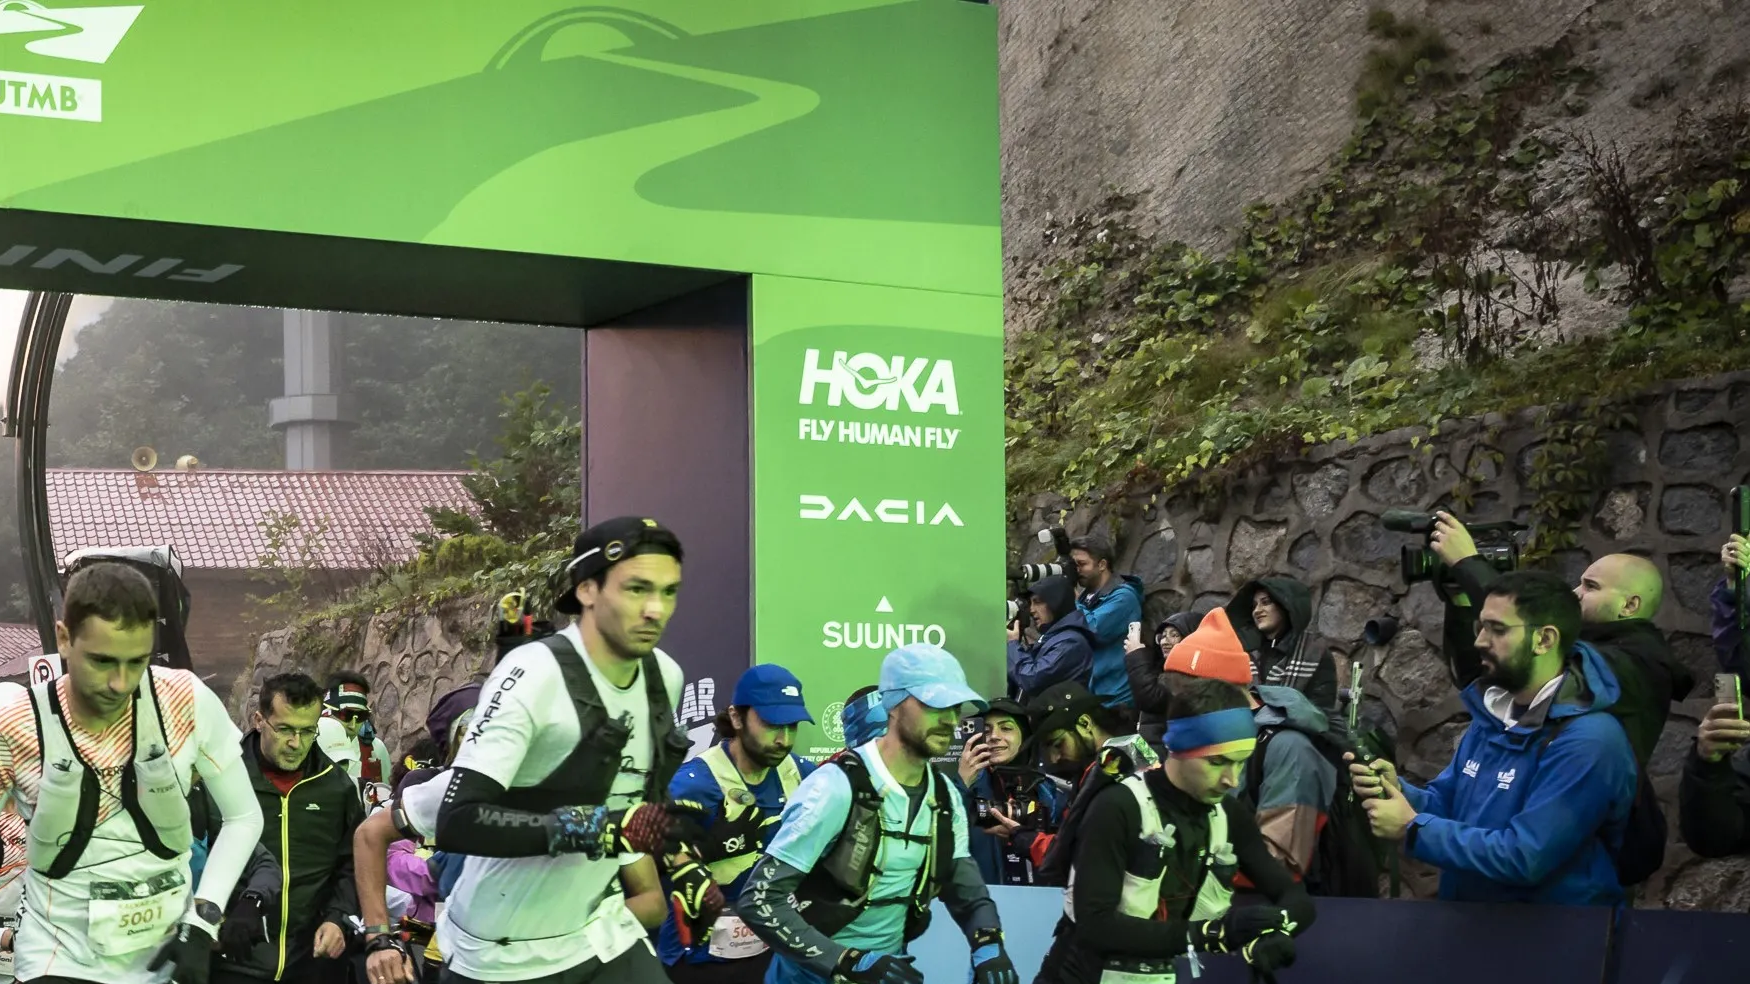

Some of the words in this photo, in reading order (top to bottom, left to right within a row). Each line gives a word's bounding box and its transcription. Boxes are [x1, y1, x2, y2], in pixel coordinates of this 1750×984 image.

[799, 348, 960, 416] HOKA
[799, 418, 835, 441] FLY
[838, 421, 921, 447] HUMAN
[925, 428, 961, 450] FLY
[800, 495, 965, 527] DACIA
[822, 620, 947, 651] SUUNTO
[473, 806, 550, 828] KARPO
[118, 906, 164, 929] 5001
